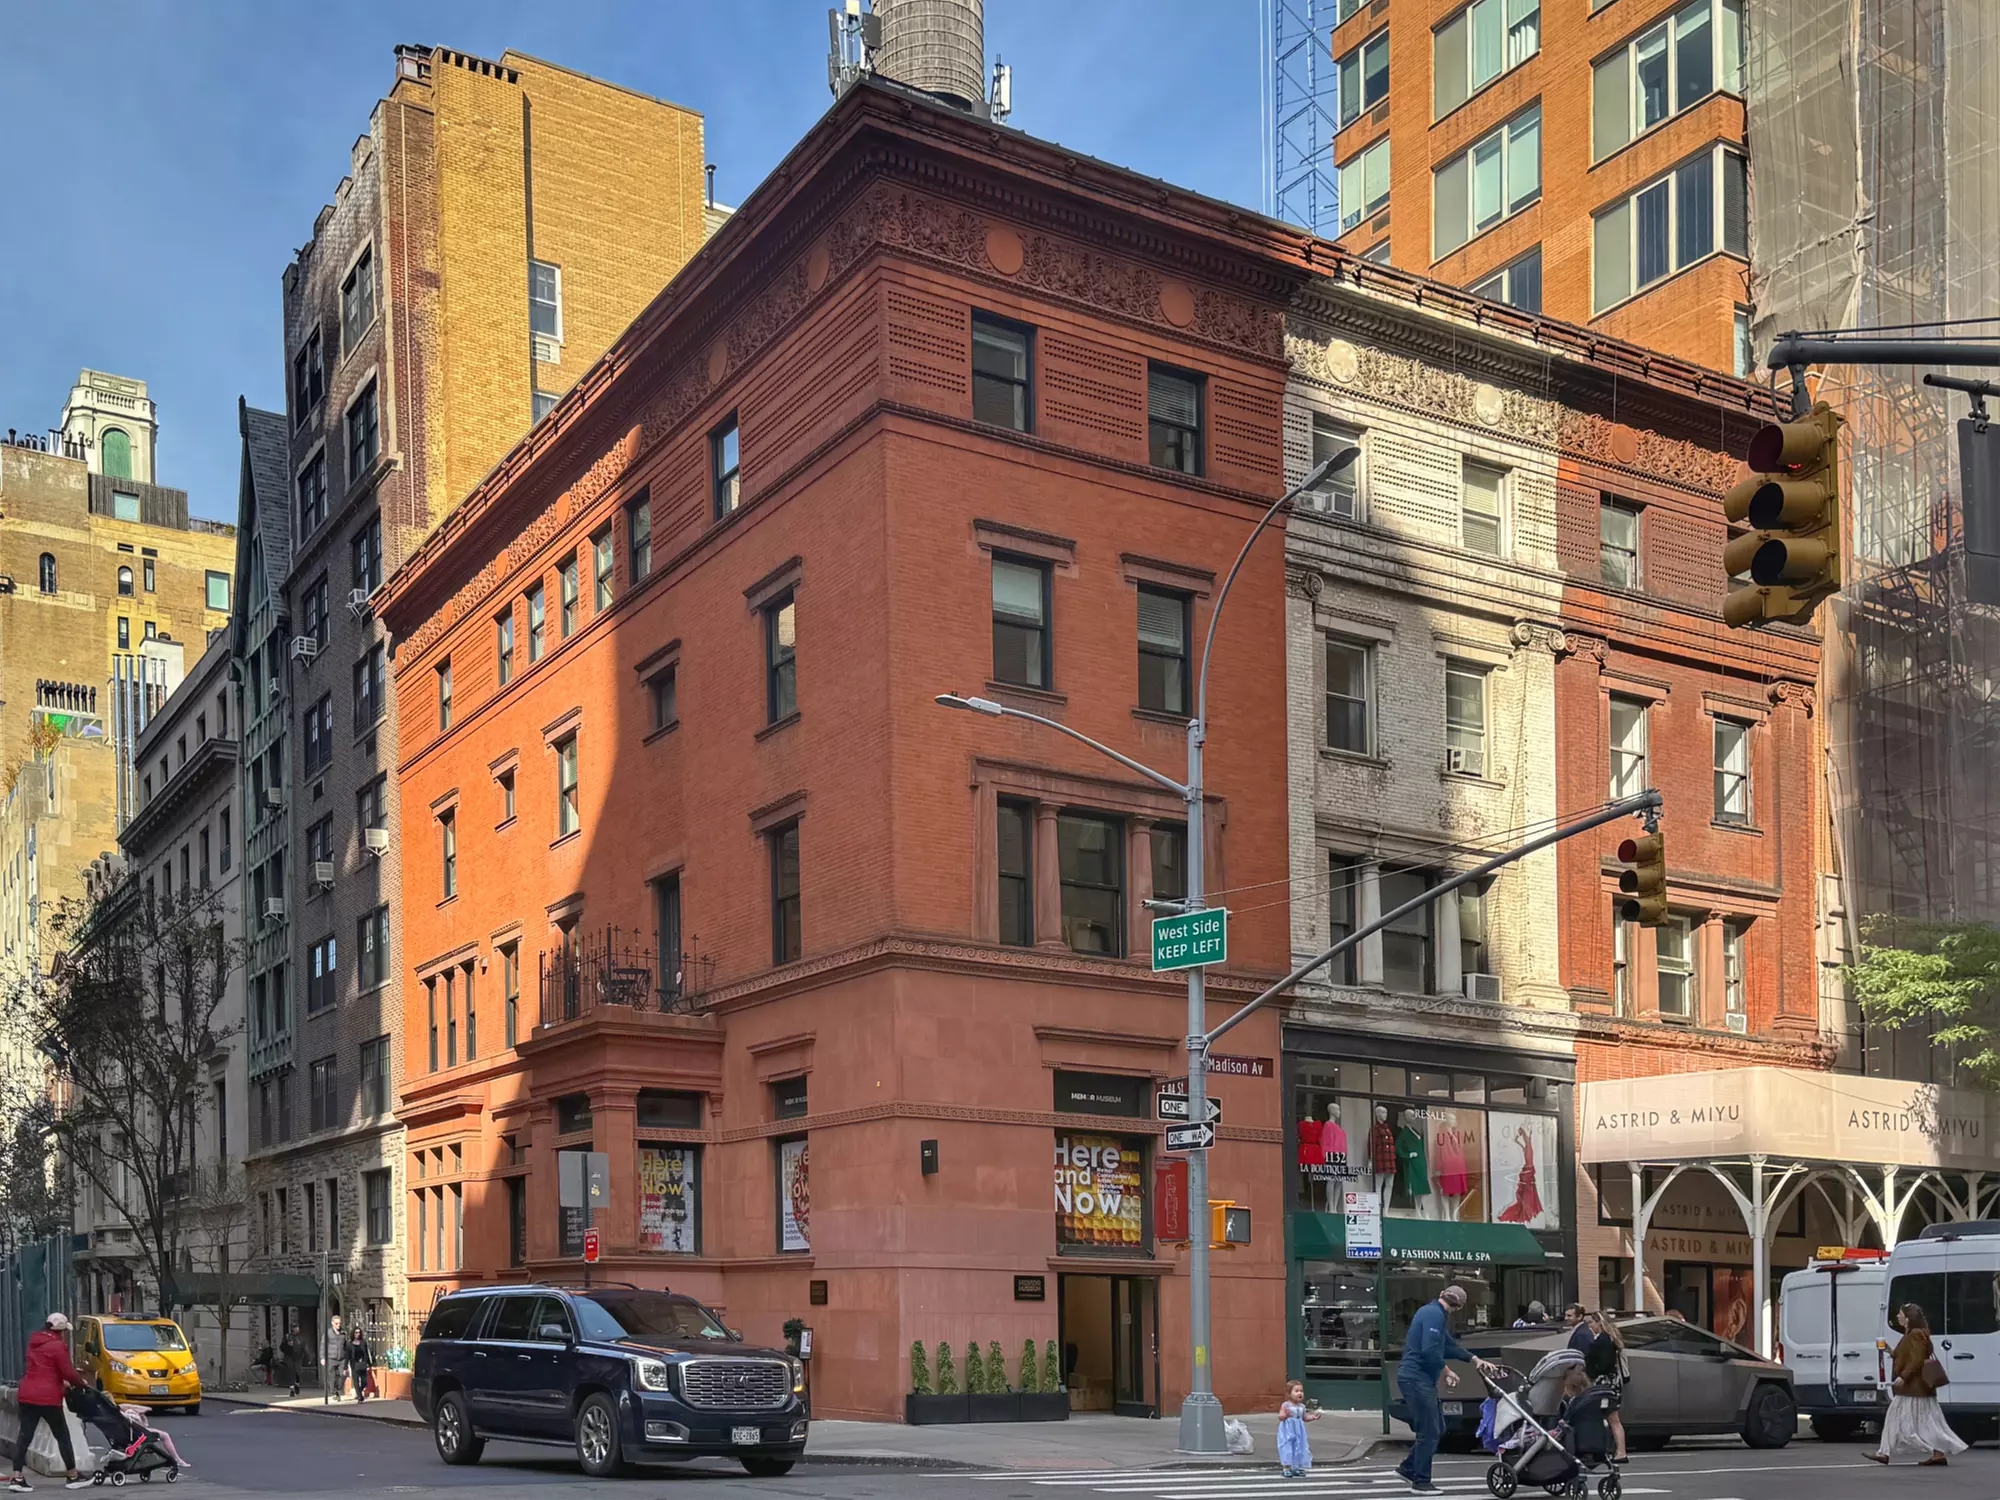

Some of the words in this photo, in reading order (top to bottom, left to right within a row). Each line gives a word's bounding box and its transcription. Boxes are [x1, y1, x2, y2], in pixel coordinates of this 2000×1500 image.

[1158, 924, 1188, 941] West
[1192, 919, 1220, 936] Side
[1158, 944, 1188, 960] KEEP
[1193, 938, 1221, 955] LEFT
[1208, 1058, 1248, 1074] Madison
[1251, 1062, 1264, 1075] Av
[1163, 1102, 1183, 1113] ONE
[1414, 1109, 1447, 1121] RESALE
[1596, 1111, 1660, 1130] ASTRID
[1670, 1109, 1681, 1125] &
[1691, 1104, 1739, 1124] MIYU
[1848, 1110, 1910, 1132] ASTRID
[1937, 1117, 1979, 1138] MIYU
[1169, 1133, 1184, 1144] ONE
[1192, 1130, 1208, 1141] WAY
[642, 1152, 683, 1172] Here
[1054, 1137, 1120, 1169] Here
[1325, 1151, 1347, 1163] 1132
[1054, 1166, 1091, 1185] and
[1300, 1163, 1309, 1172] LA
[1311, 1164, 1347, 1176] BOUTIQUE
[1348, 1165, 1372, 1176] RESALE
[1662, 1204, 1700, 1217] ASTRID
[1401, 1249, 1440, 1260] FASHION
[1443, 1251, 1464, 1260] NAIL
[1466, 1252, 1473, 1260] &
[1475, 1252, 1491, 1261] SPA
[1651, 1236, 1702, 1254] ASTRID
[1709, 1239, 1719, 1254] &
[1725, 1240, 1751, 1256] MIY
